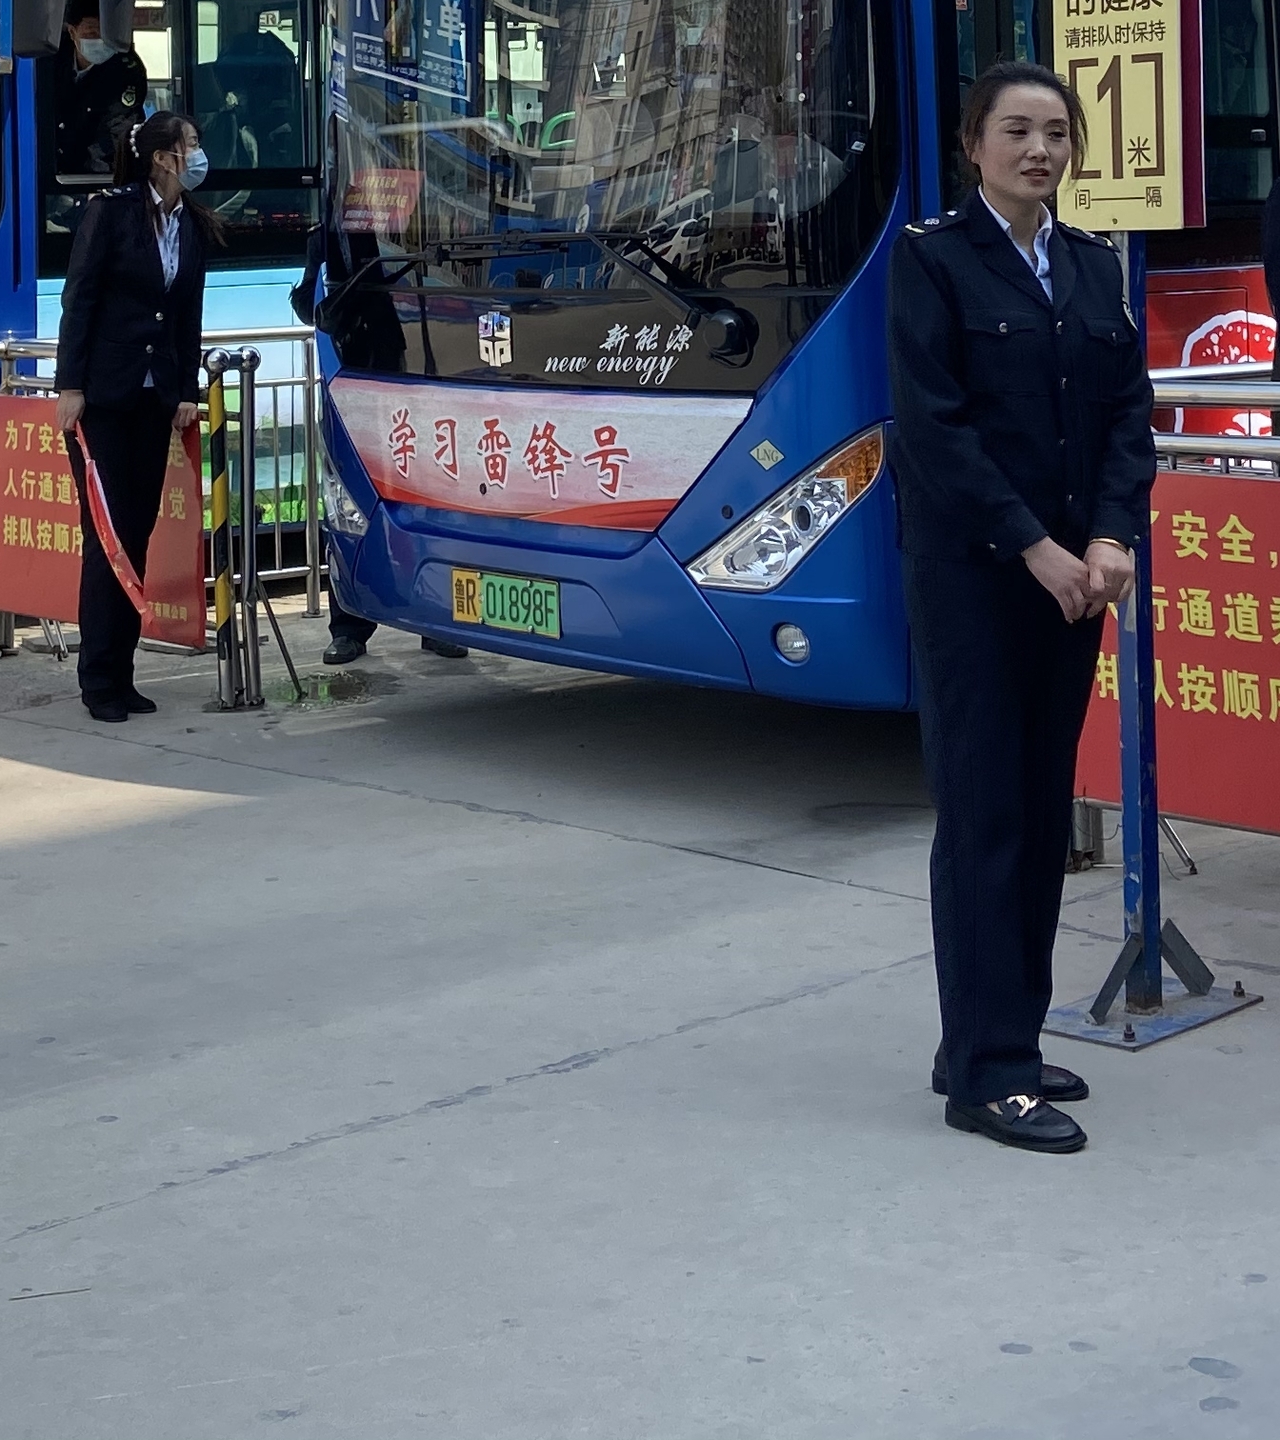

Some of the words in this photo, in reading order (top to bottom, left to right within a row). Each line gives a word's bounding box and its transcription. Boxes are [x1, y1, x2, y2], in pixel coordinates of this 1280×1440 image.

[1064, 19, 1167, 50] 请排队时保持
[599, 323, 695, 352] 新能源
[544, 355, 591, 373] new
[596, 354, 681, 386] energy
[387, 408, 631, 500] 学习雷锋号
[754, 446, 780, 463] LNG
[3, 467, 79, 506] 人行通道
